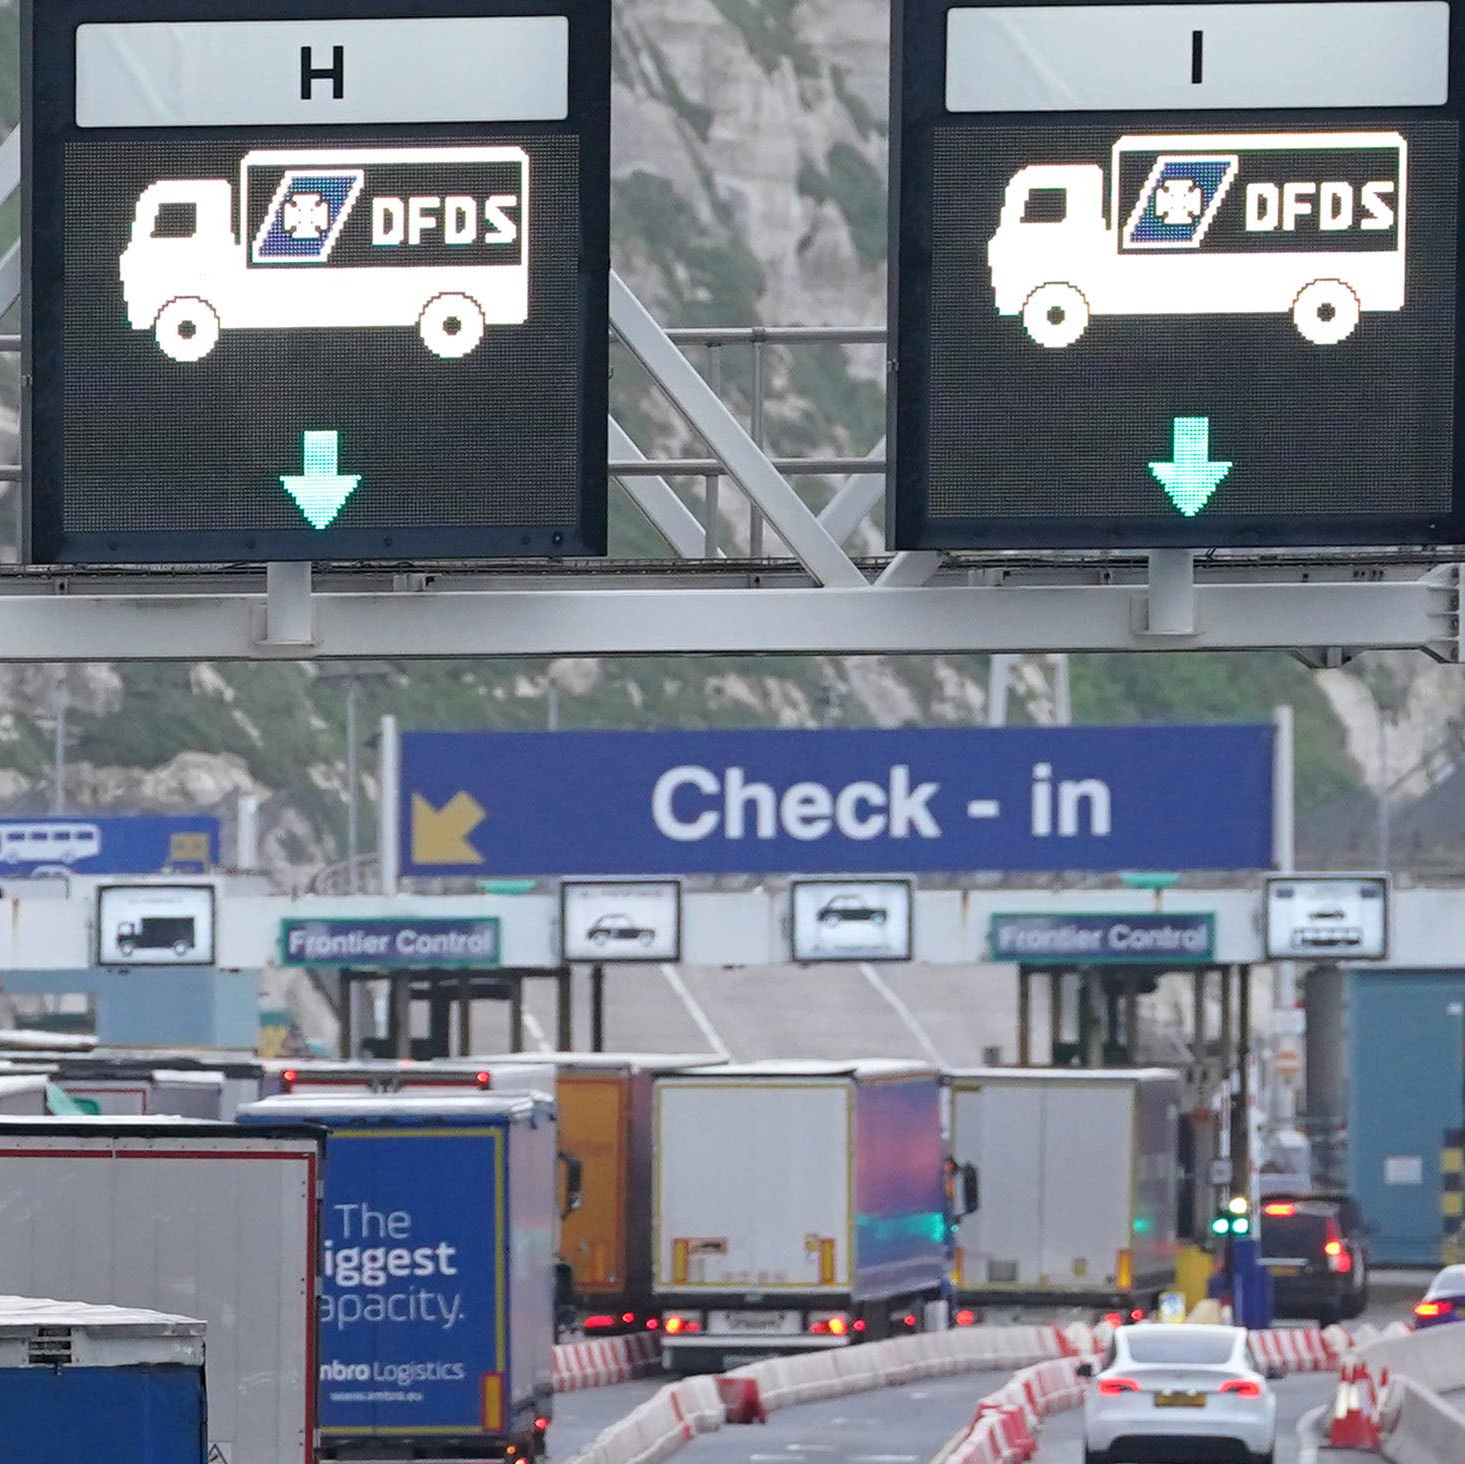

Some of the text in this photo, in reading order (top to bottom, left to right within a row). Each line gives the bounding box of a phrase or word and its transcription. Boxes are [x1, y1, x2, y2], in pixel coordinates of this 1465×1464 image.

[301, 46, 344, 100] H
[1192, 31, 1203, 84] I
[372, 194, 518, 246] DFDS
[1244, 180, 1396, 232] DFDS
[651, 764, 942, 842] Check
[1031, 762, 1112, 838] in
[288, 928, 492, 955] Frontier Control
[999, 924, 1209, 950] Frontier Control
[334, 1202, 413, 1239] The
[324, 1239, 459, 1287] iggest
[321, 1285, 465, 1330] apacity.
[373, 1360, 467, 1387] Logistics
